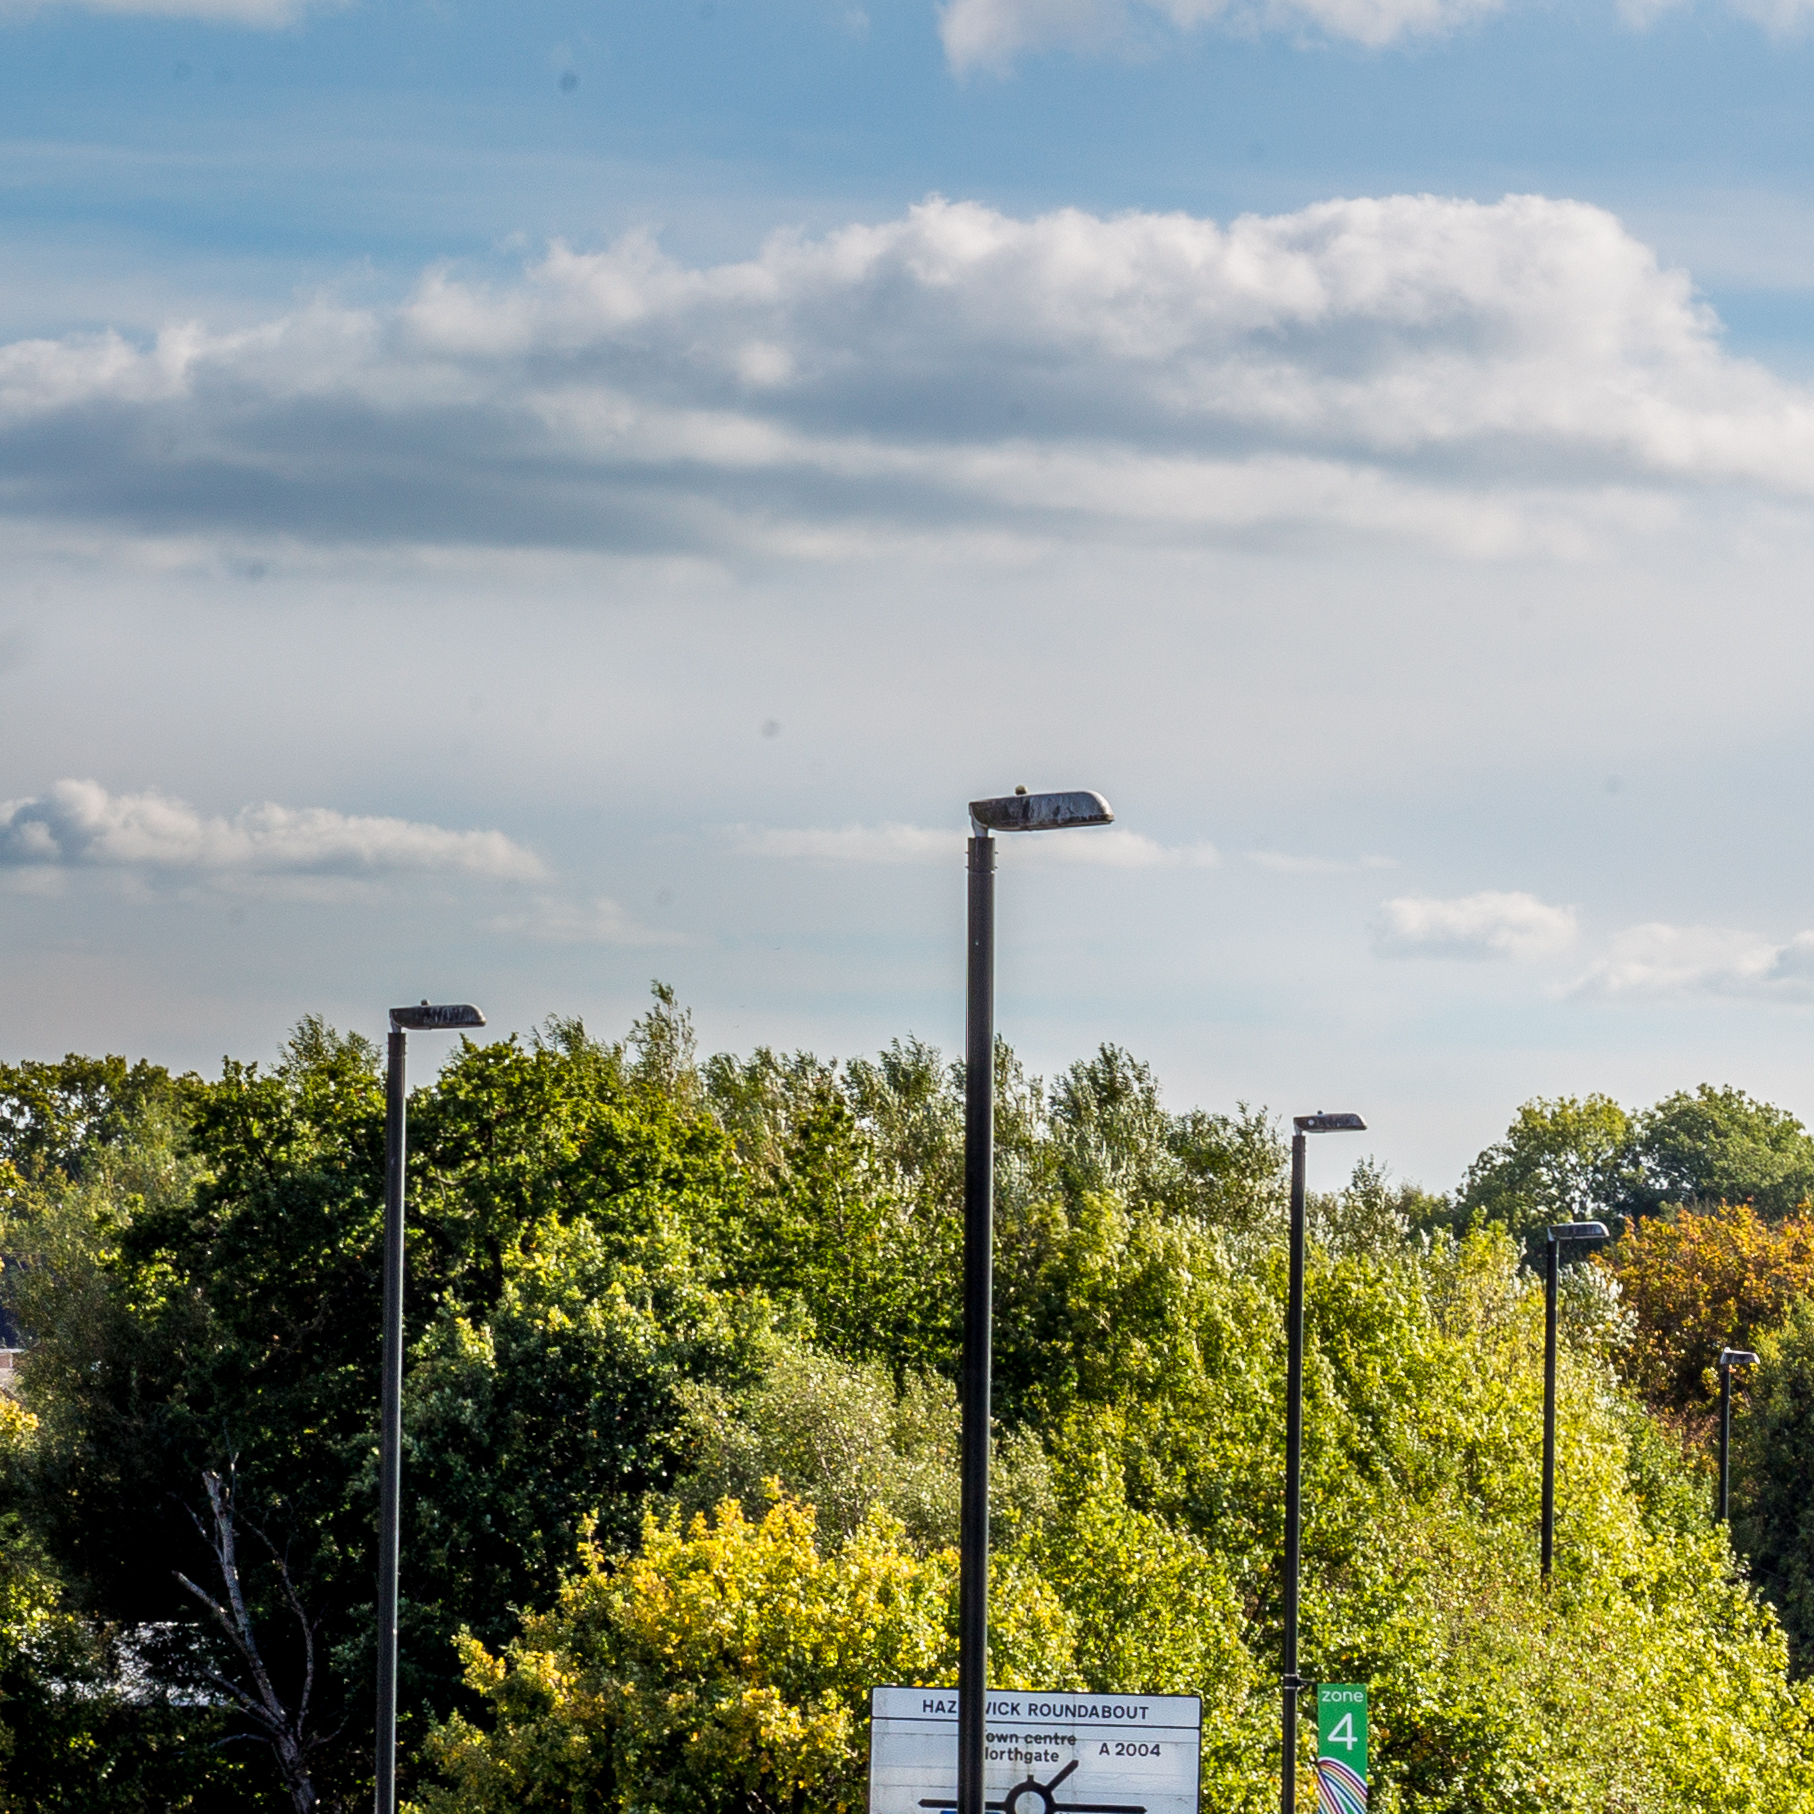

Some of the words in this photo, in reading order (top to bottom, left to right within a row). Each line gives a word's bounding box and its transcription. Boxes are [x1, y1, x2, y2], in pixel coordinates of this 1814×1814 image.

[1321, 1690, 1364, 1703] zone
[1028, 1703, 1150, 1720] ROUNDABOUT
[985, 1729, 1019, 1744] own
[1026, 1732, 1077, 1746] centre
[1327, 1713, 1358, 1751] 4
[1100, 1743, 1110, 1756] A
[1115, 1743, 1161, 1757] 2004
